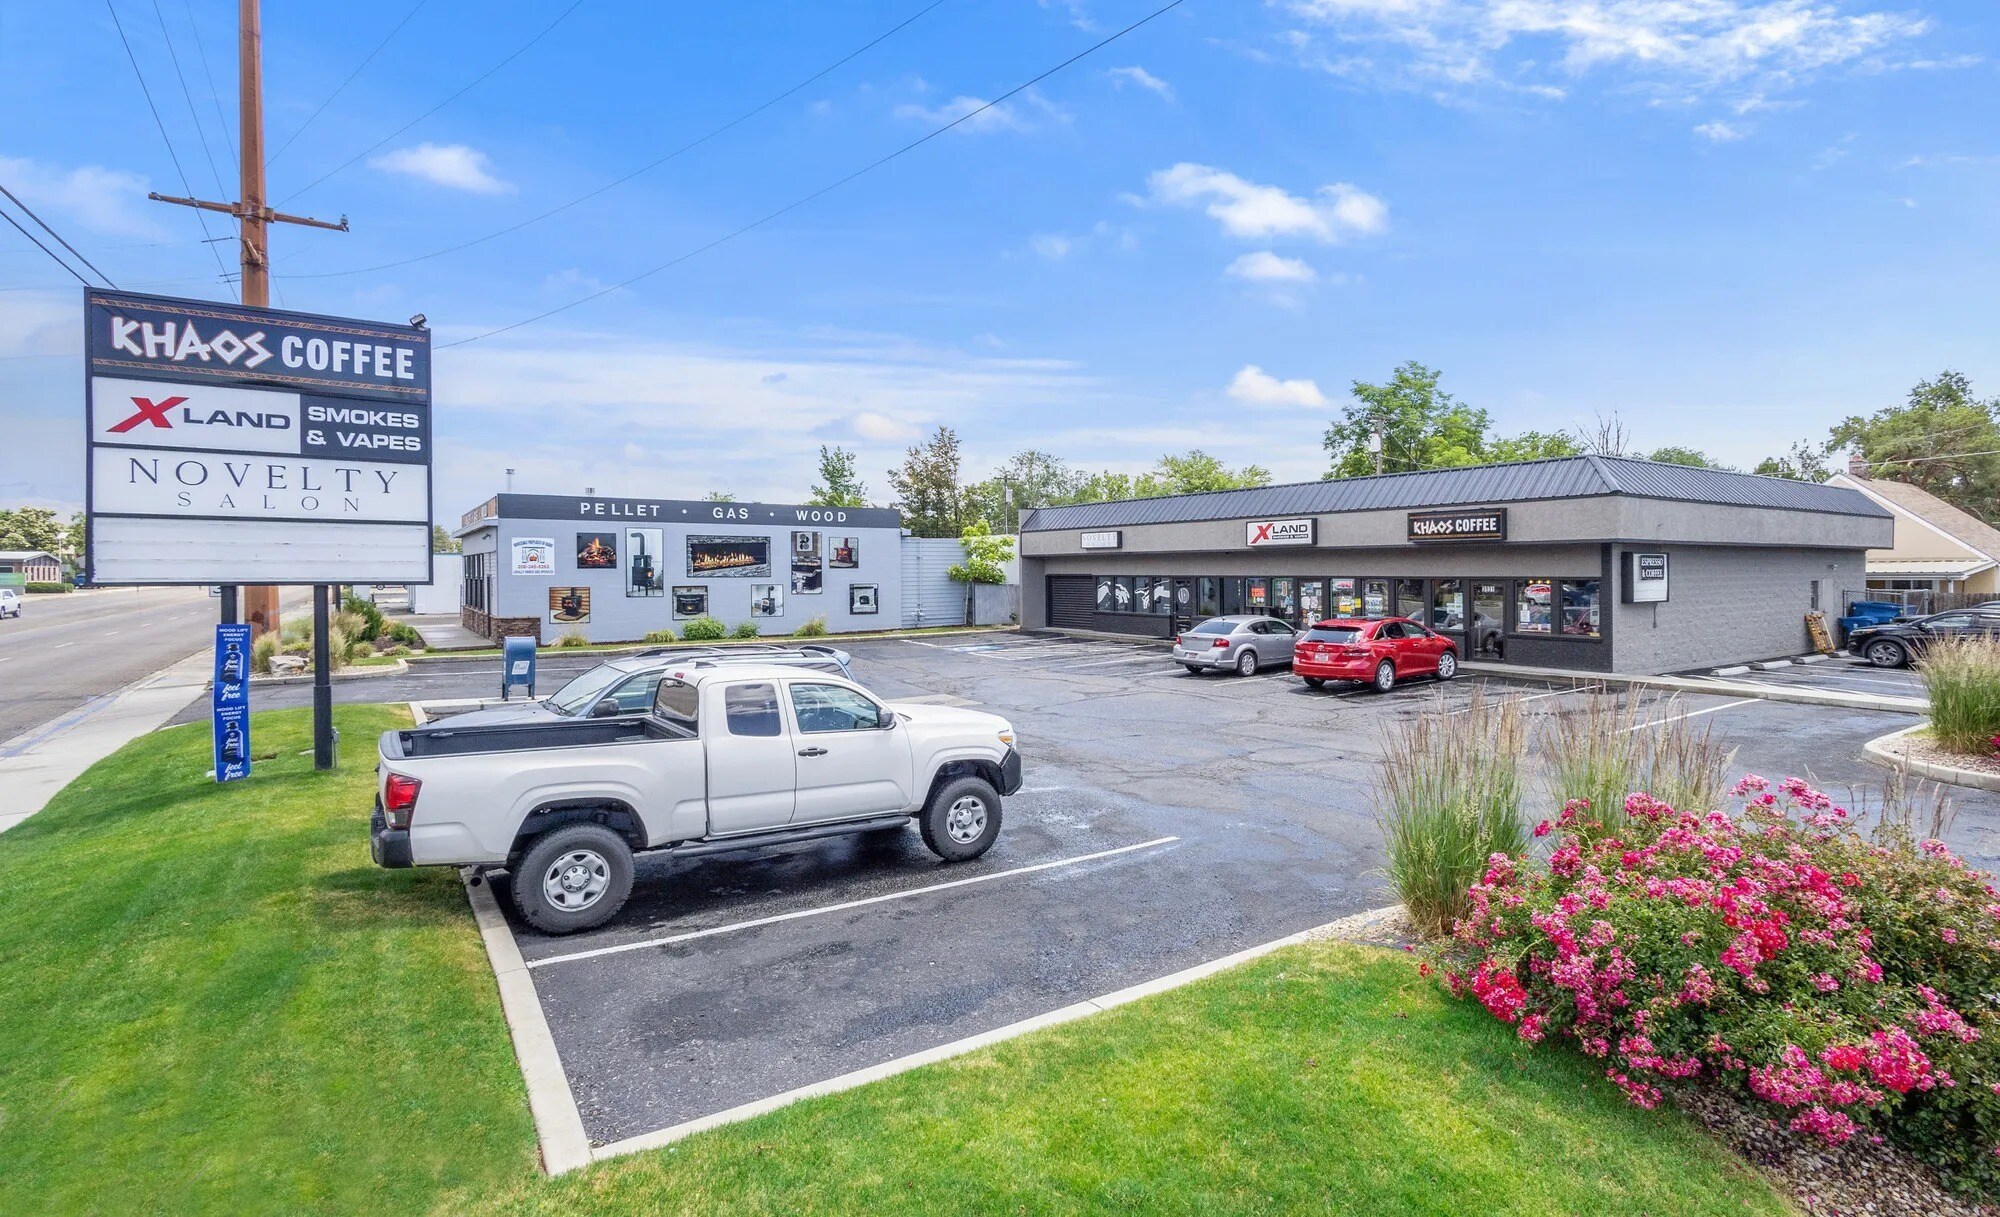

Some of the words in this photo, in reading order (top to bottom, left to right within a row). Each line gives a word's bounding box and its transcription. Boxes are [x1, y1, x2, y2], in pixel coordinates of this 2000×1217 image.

[111, 316, 274, 369] KHAOS
[281, 335, 415, 380] COFFEE
[307, 406, 419, 428] SMOKES
[306, 430, 327, 446] &
[336, 431, 421, 451] VAPES
[128, 457, 399, 494] NOVELTY
[177, 491, 360, 512] SALON
[580, 502, 660, 517] PELLET
[712, 507, 749, 520] GAS
[796, 510, 847, 522] WOOD
[1413, 519, 1454, 534] KHAOS
[1455, 518, 1497, 532] COFFEE
[1641, 557, 1664, 566] ESPRESSO
[1645, 569, 1663, 577] COFFEE
[221, 691, 241, 701] free
[222, 683, 241, 694] feel
[224, 762, 243, 773] feel
[224, 770, 243, 781] free
